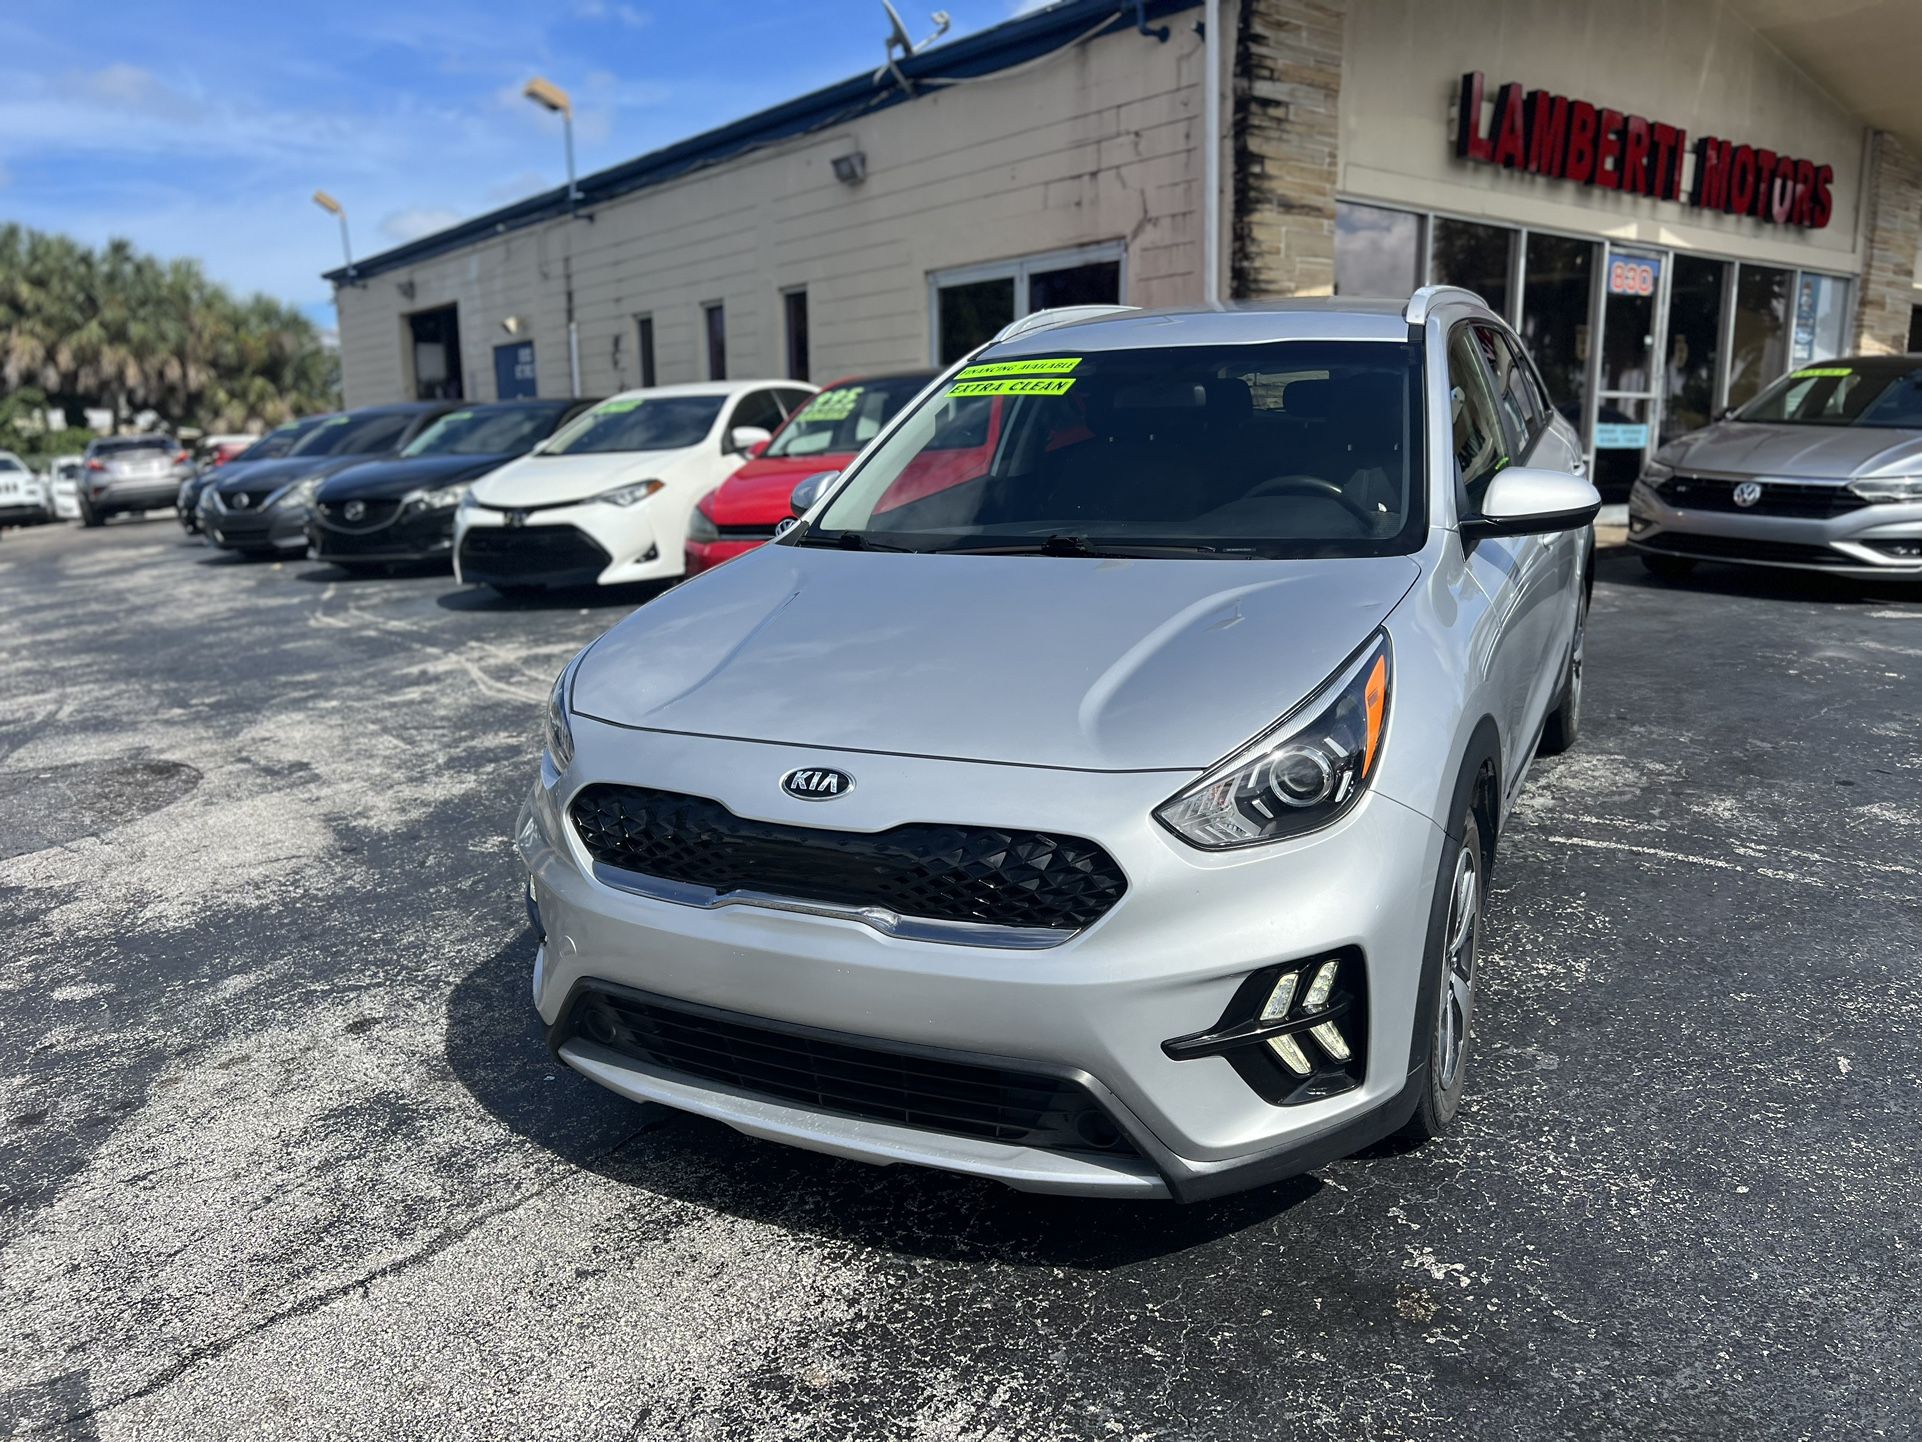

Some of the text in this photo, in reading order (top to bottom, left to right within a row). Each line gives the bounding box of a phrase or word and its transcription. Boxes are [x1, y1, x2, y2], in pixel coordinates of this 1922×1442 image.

[1458, 71, 1834, 229] LAMBERTI MOTORS
[950, 381, 1067, 393] EXTRA CLEAN
[790, 771, 839, 793] KIA
